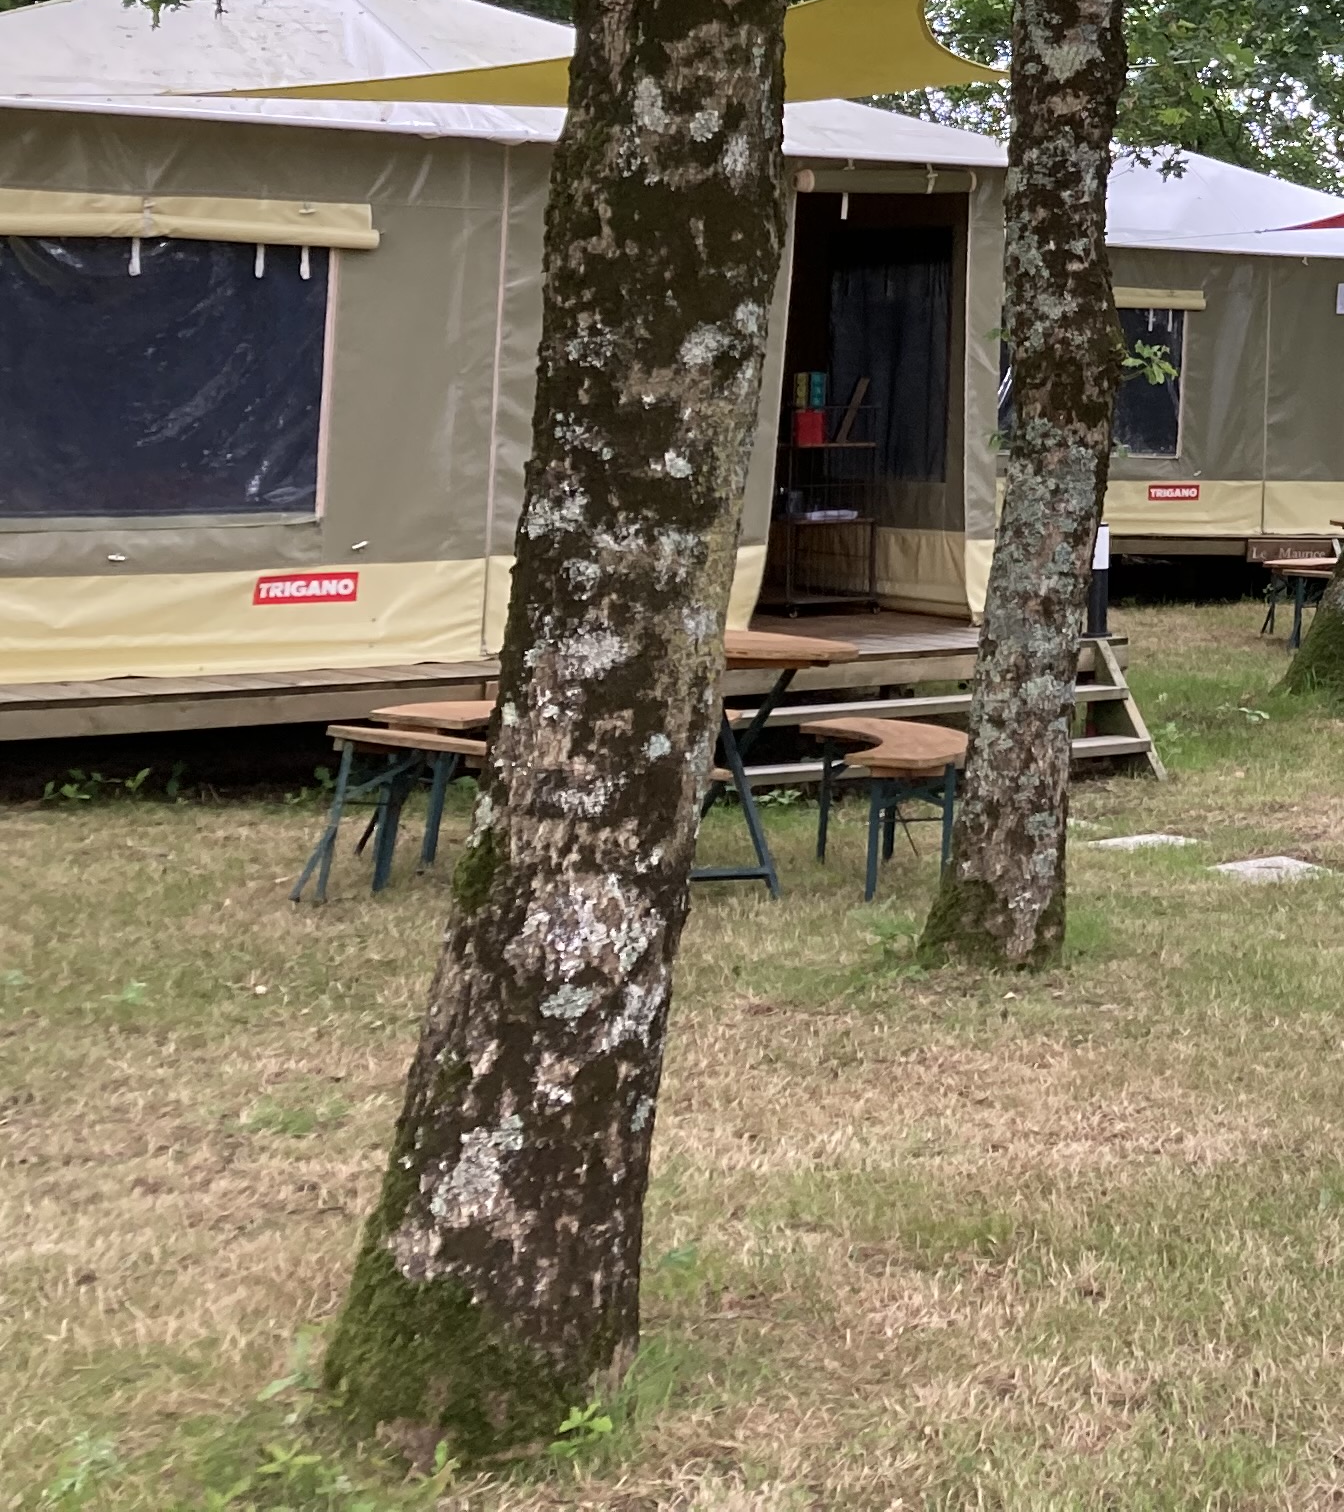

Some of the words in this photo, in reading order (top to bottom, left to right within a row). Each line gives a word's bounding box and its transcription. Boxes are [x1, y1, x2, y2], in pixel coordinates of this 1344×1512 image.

[1150, 487, 1198, 498] TRIGANO
[1252, 547, 1267, 559] Le
[1279, 547, 1326, 559] Maurice
[259, 578, 355, 599] TRIGANO
